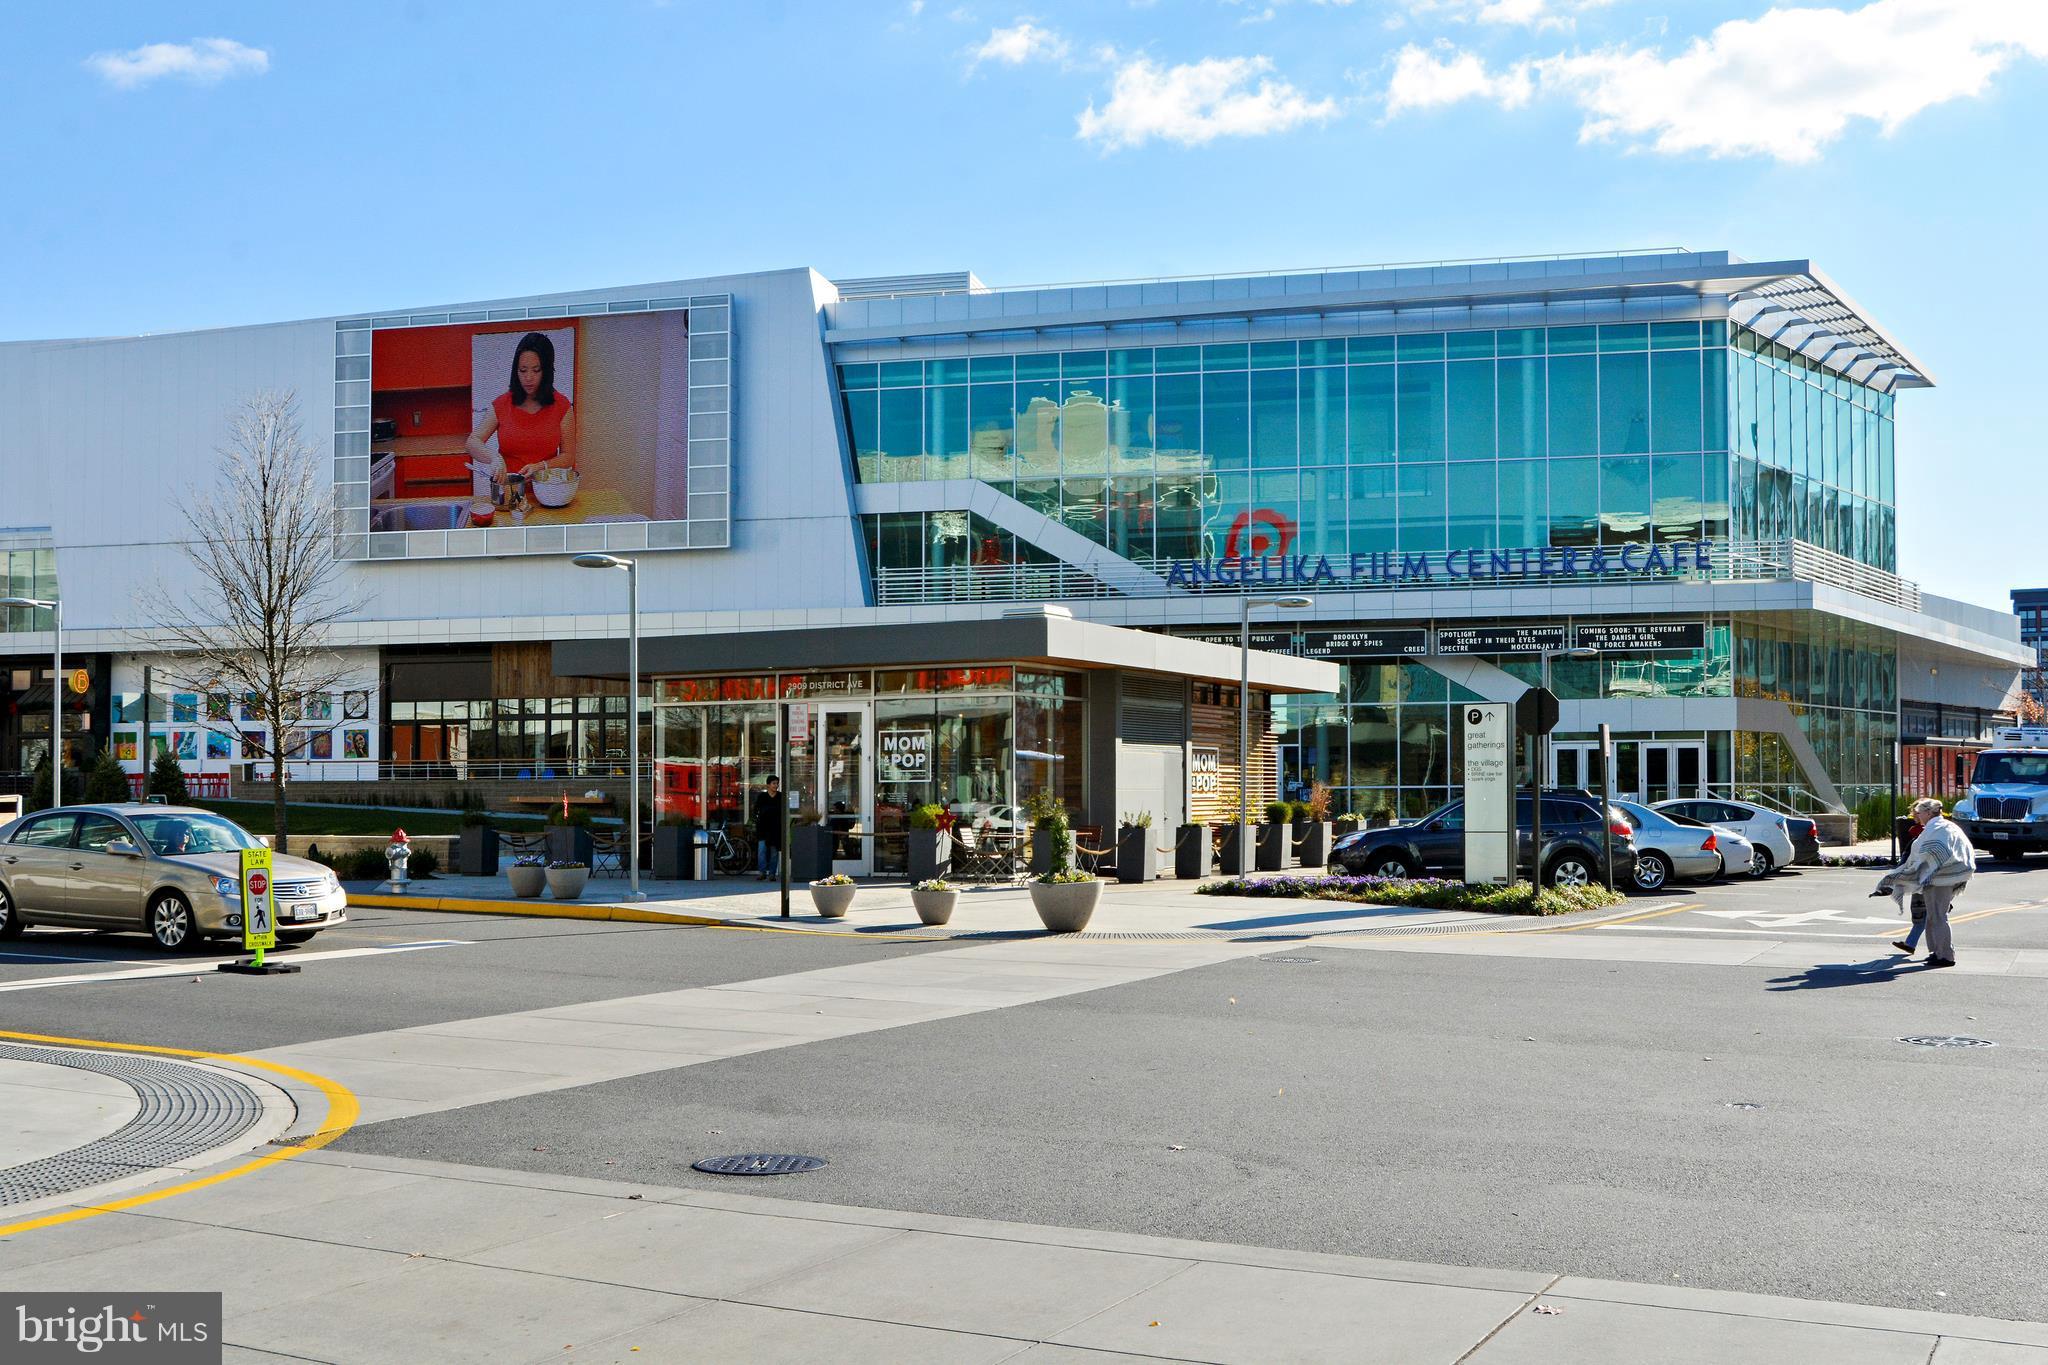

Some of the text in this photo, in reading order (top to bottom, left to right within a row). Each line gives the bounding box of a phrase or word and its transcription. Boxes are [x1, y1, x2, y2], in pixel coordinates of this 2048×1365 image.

[1166, 554, 1334, 587] ANGELIKA
[1350, 551, 1430, 580] FILM
[1445, 546, 1577, 577] CENTER
[1589, 547, 1608, 573] &
[787, 680, 863, 690] 2909 DISTRICT AVE
[1471, 712, 1479, 721] P
[1467, 732, 1486, 740] great
[884, 736, 925, 751] MOM
[1467, 742, 1505, 750] gatherings
[891, 753, 926, 767] POP
[1192, 754, 1217, 772] MOM
[1480, 760, 1504, 768] village
[1196, 775, 1217, 792] POP
[249, 880, 266, 889] STOP
